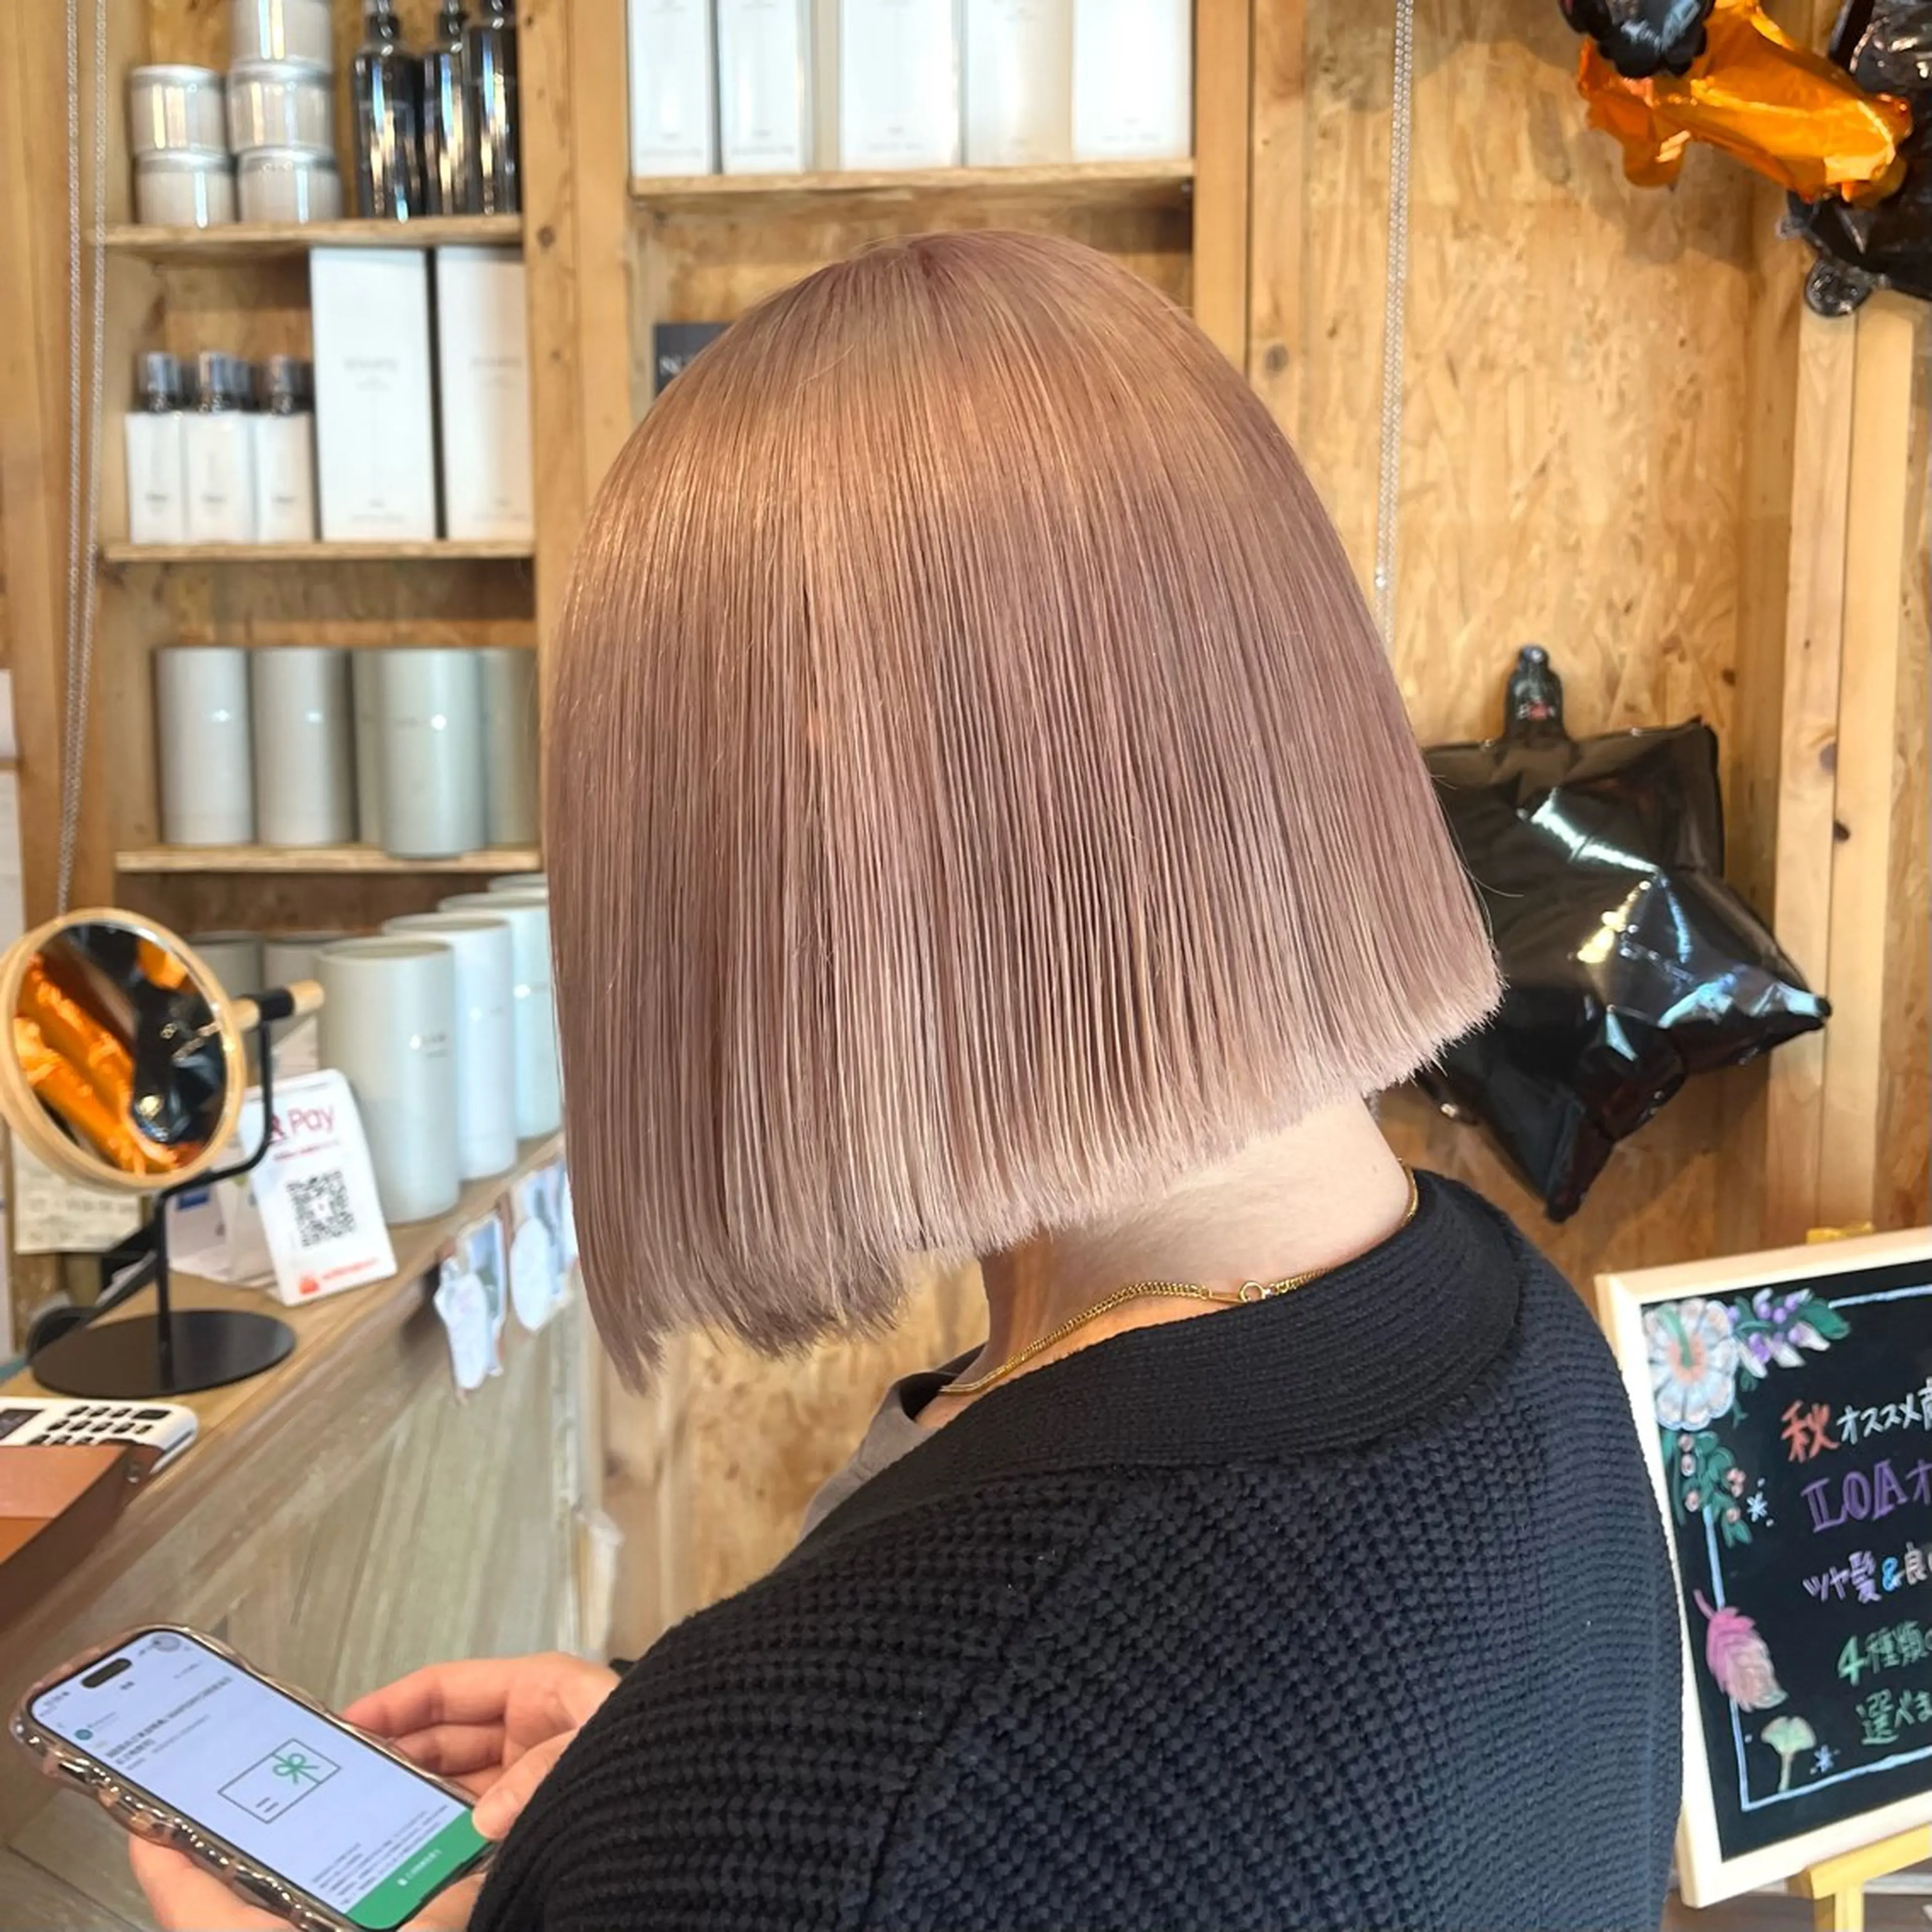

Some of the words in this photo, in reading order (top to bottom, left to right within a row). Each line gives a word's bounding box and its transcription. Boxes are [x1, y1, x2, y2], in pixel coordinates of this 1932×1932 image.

[287, 1105, 335, 1137] Pay
[1802, 1541, 1932, 1604] ツヤ髪&良
